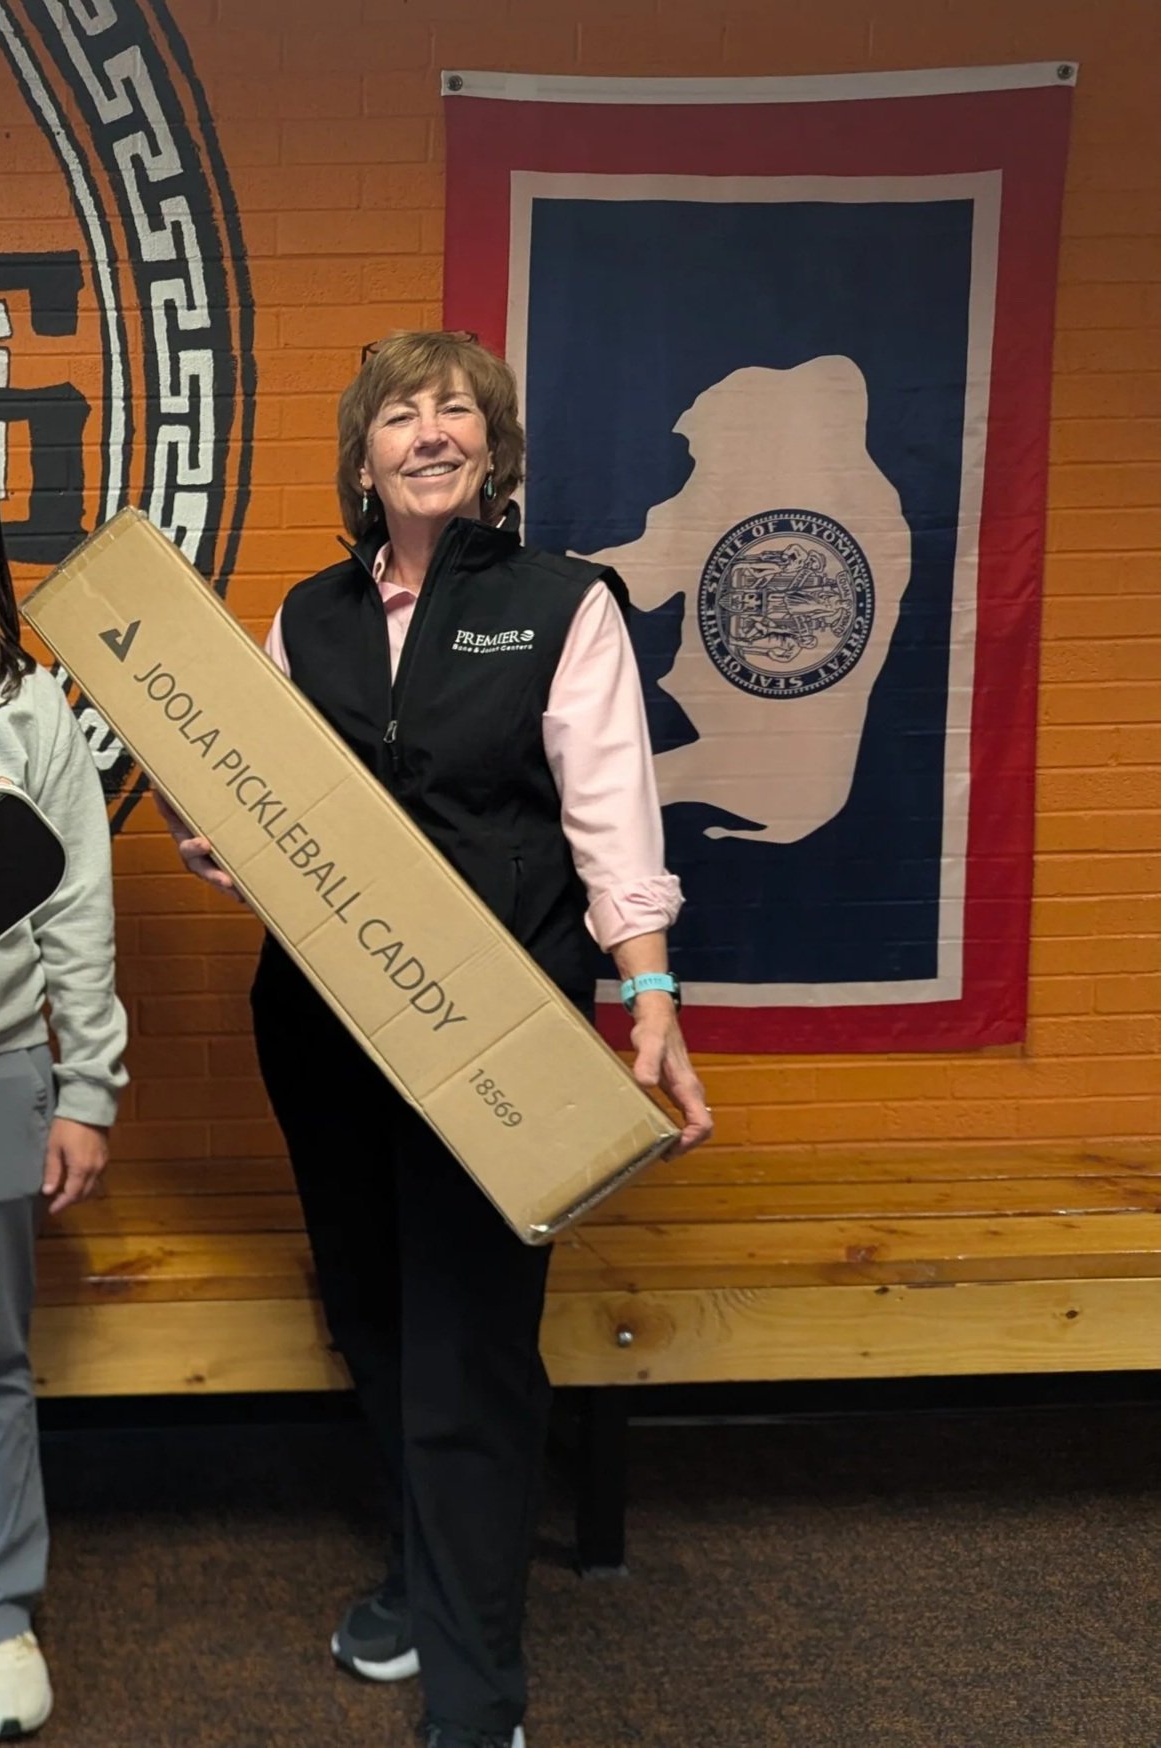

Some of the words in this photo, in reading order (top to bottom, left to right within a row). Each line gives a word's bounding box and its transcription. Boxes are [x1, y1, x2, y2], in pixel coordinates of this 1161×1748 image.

[751, 519, 779, 538] OF
[706, 533, 750, 594] STATE
[789, 518, 867, 593] WYOMING
[837, 572, 853, 602] EQUAL
[455, 629, 521, 647] PREMIER
[704, 608, 724, 650] THE
[452, 643, 473, 653] Bone
[480, 646, 500, 654] Joint
[500, 643, 534, 652] Centers
[720, 652, 742, 675] OF
[818, 616, 867, 681] GREAT
[748, 675, 805, 690] SEAL
[133, 662, 221, 759] JOOLA
[212, 748, 362, 925] PICKLEBALL
[358, 918, 469, 1032] CADDY
[468, 1067, 524, 1130] 18569
